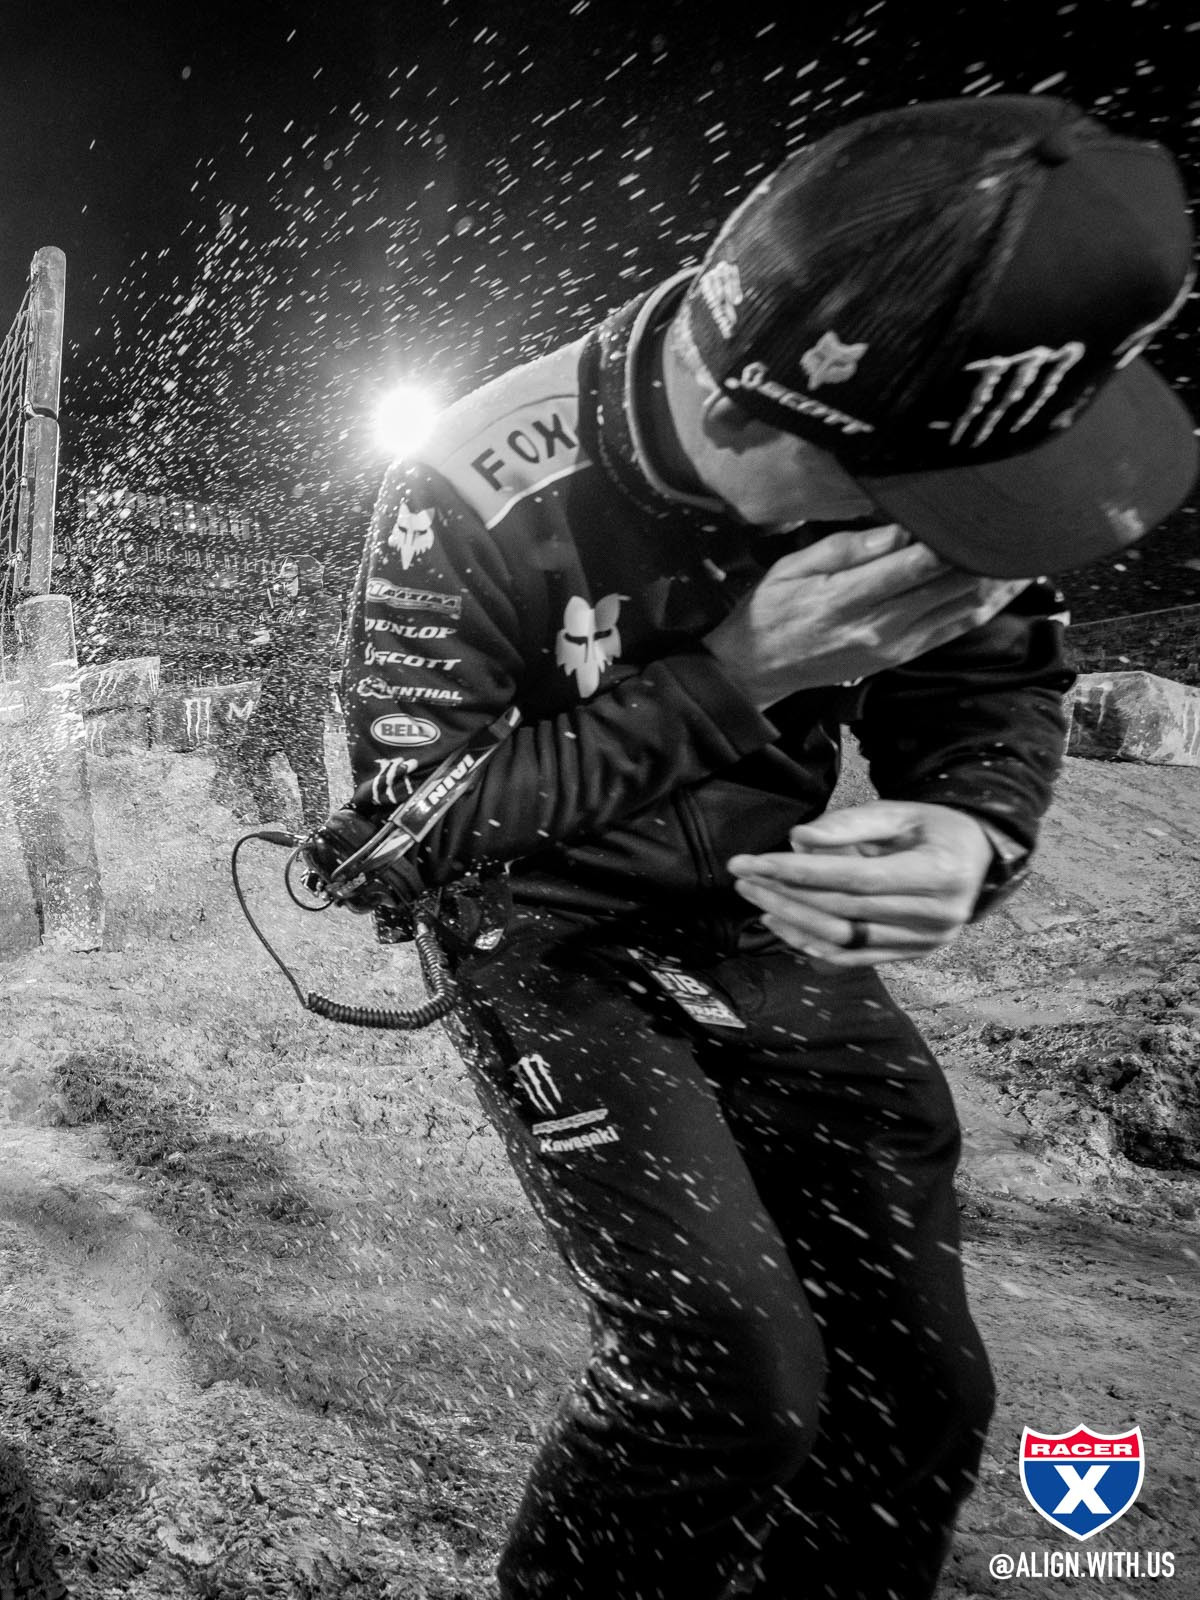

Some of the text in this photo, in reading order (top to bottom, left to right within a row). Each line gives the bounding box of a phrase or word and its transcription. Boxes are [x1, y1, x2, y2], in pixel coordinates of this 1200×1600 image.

[471, 413, 577, 492] FOX
[364, 617, 458, 639] DUNLOP
[374, 650, 463, 671] SCOTT
[381, 723, 431, 738] BELL
[541, 1125, 620, 1153] Kawasaki
